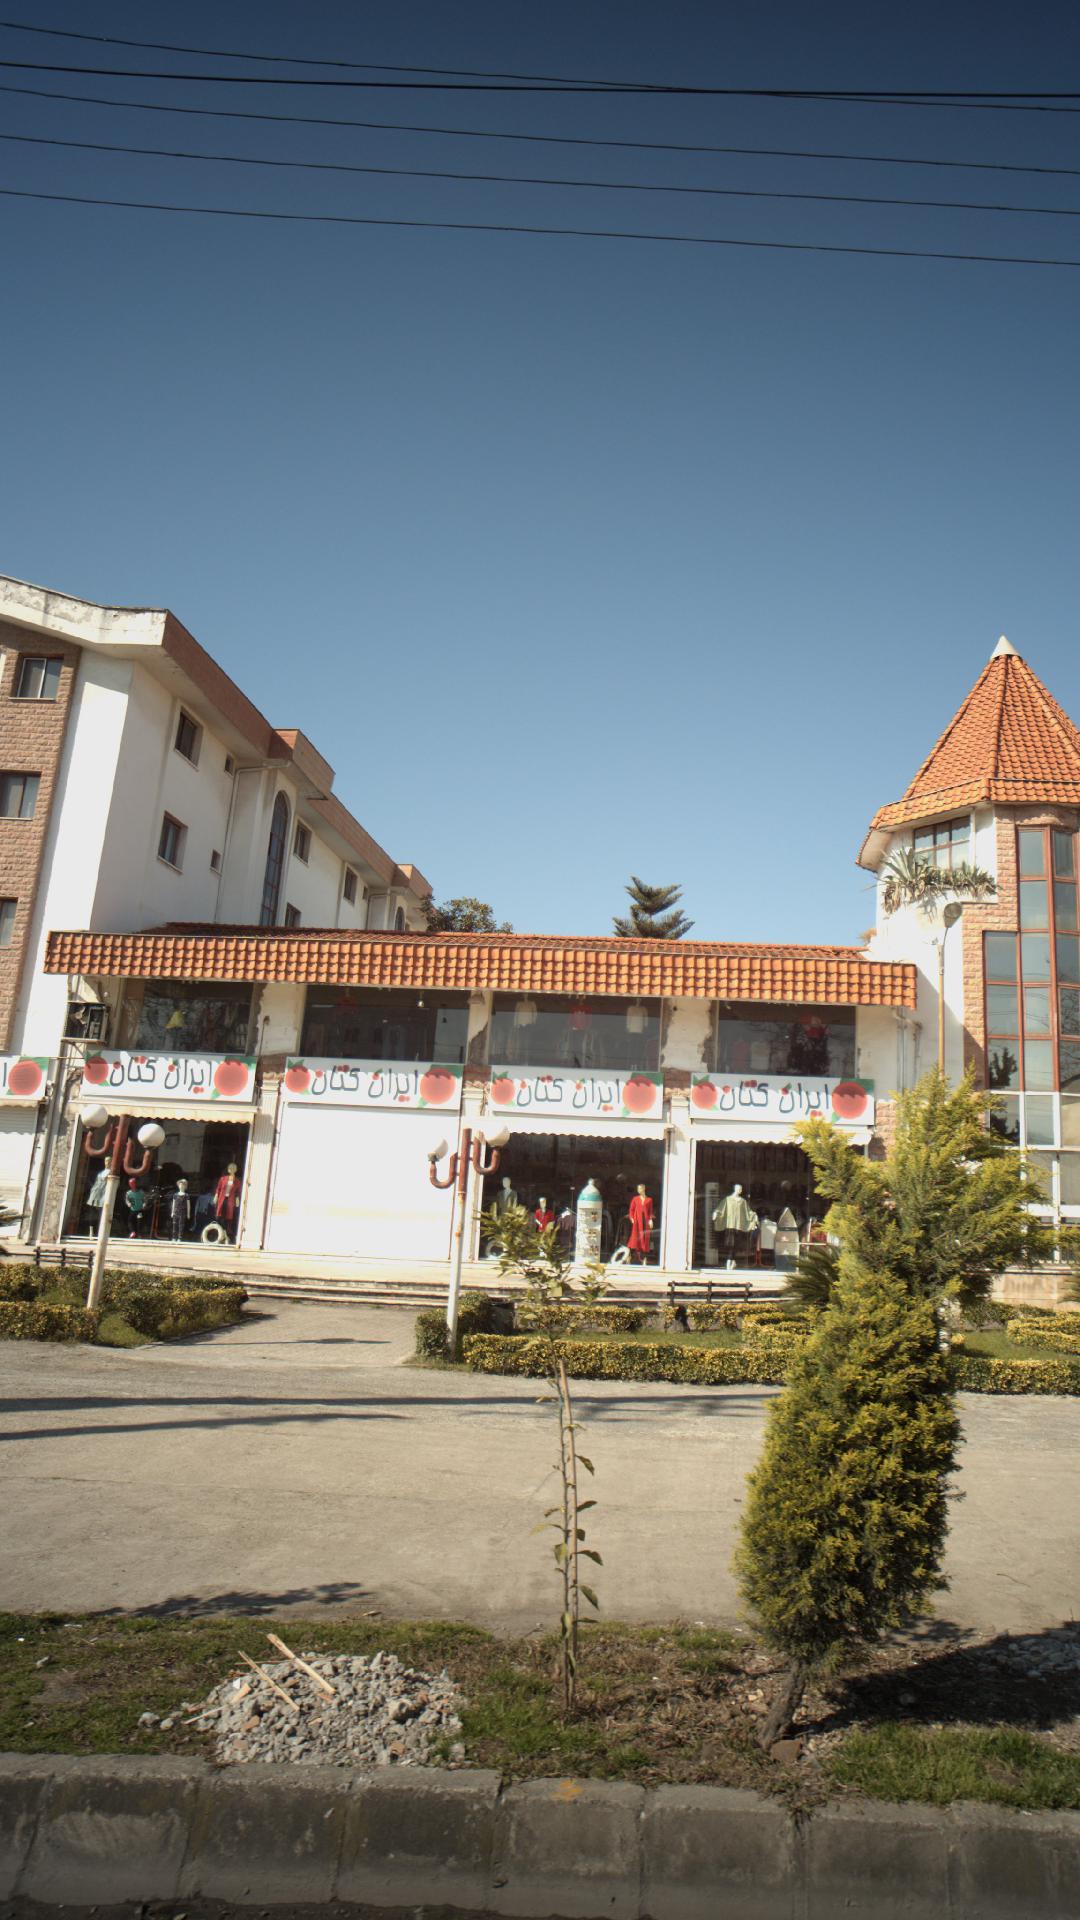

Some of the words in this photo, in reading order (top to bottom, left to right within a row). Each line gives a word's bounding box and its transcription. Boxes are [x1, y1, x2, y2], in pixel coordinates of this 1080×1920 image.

[109, 1056, 157, 1088] کتان
[164, 1059, 213, 1094] ایران
[311, 1064, 361, 1096] کتان
[368, 1068, 419, 1102] ایران
[516, 1075, 564, 1107] کتان
[572, 1077, 621, 1112] ایران
[719, 1079, 769, 1111] کتان
[778, 1082, 830, 1117] ایران
